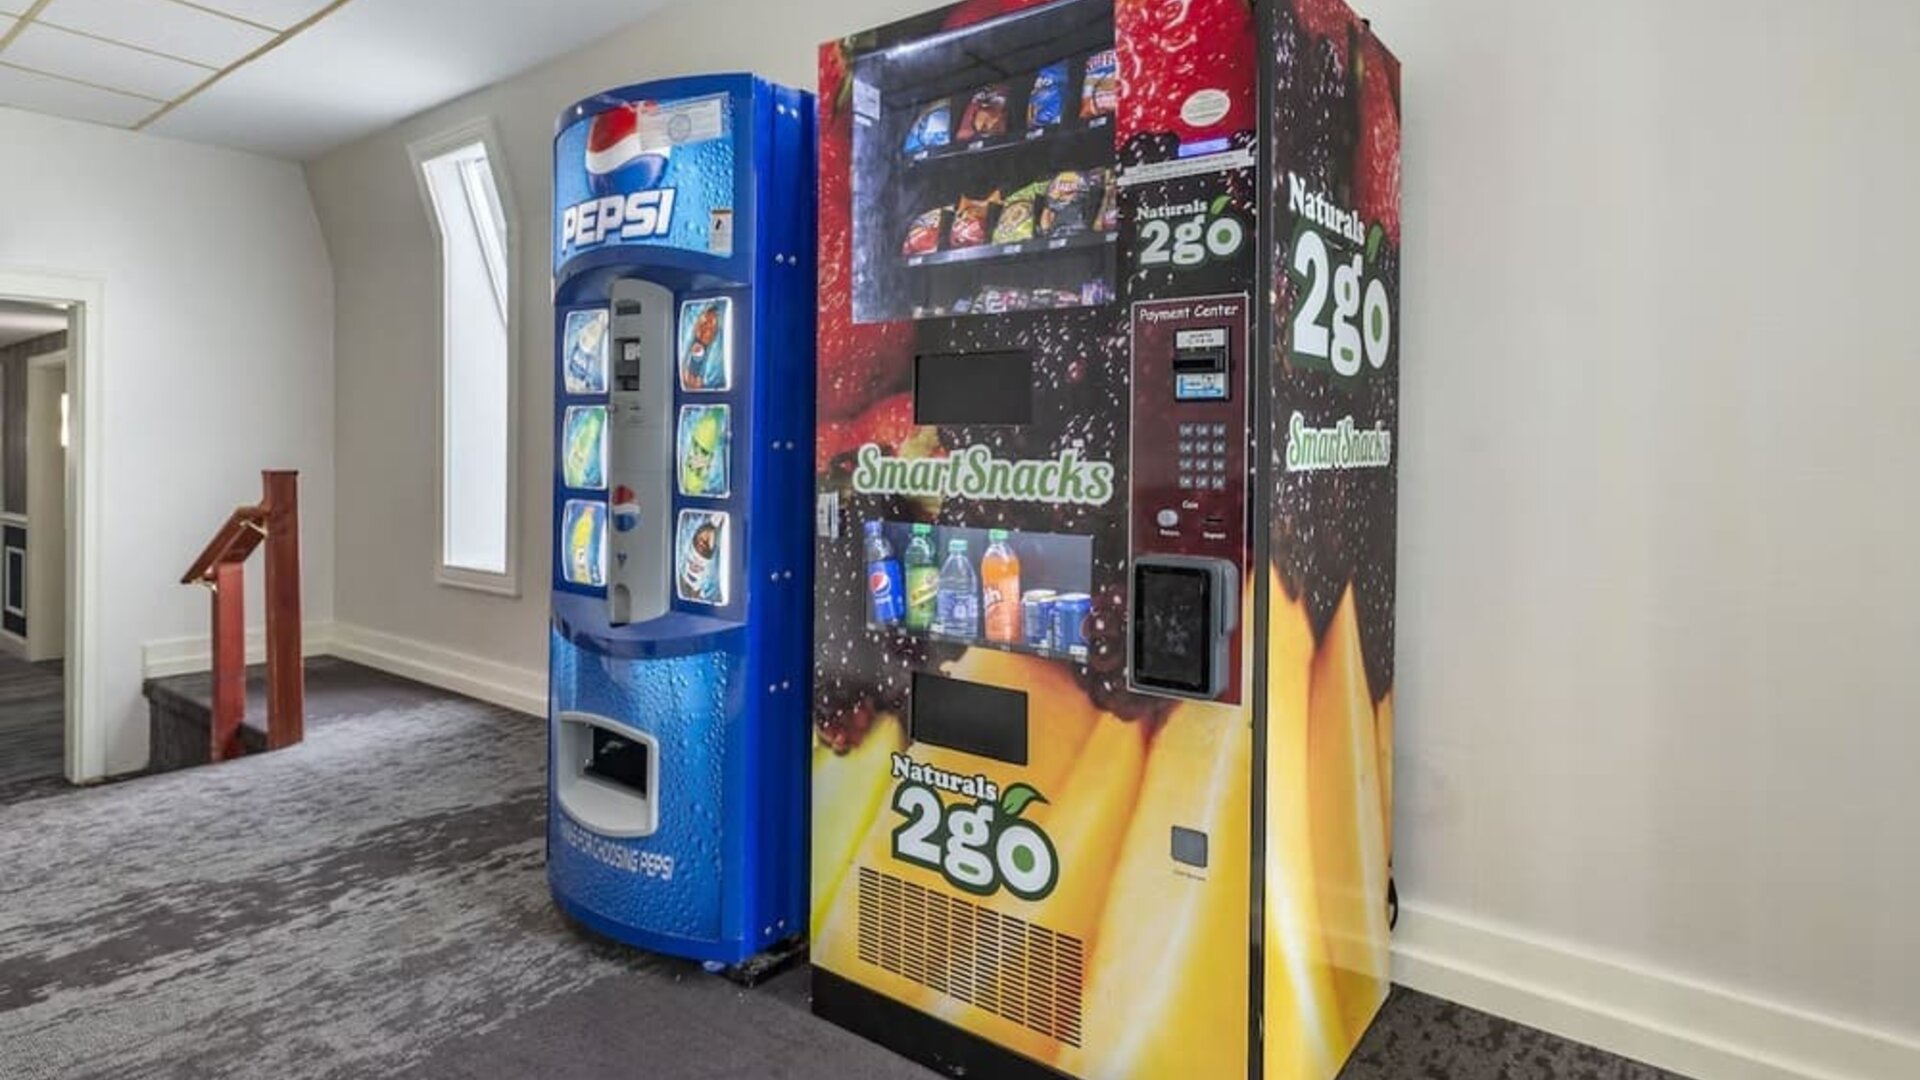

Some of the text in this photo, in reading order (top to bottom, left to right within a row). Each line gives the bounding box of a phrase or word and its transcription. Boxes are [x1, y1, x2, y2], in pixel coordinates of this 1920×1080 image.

[562, 187, 676, 251] PEPSI
[1136, 199, 1208, 221] Naturals
[1139, 214, 1242, 265] 2go
[1288, 172, 1365, 246] Naturals
[1139, 304, 1239, 324] Payment Center
[1292, 229, 1391, 377] 2go
[1286, 411, 1391, 473] SmartSnacks
[853, 443, 1114, 504] SmartSnacks
[892, 753, 998, 802] Naturals
[639, 850, 675, 881] PEPSI
[892, 782, 1059, 901] 2go
